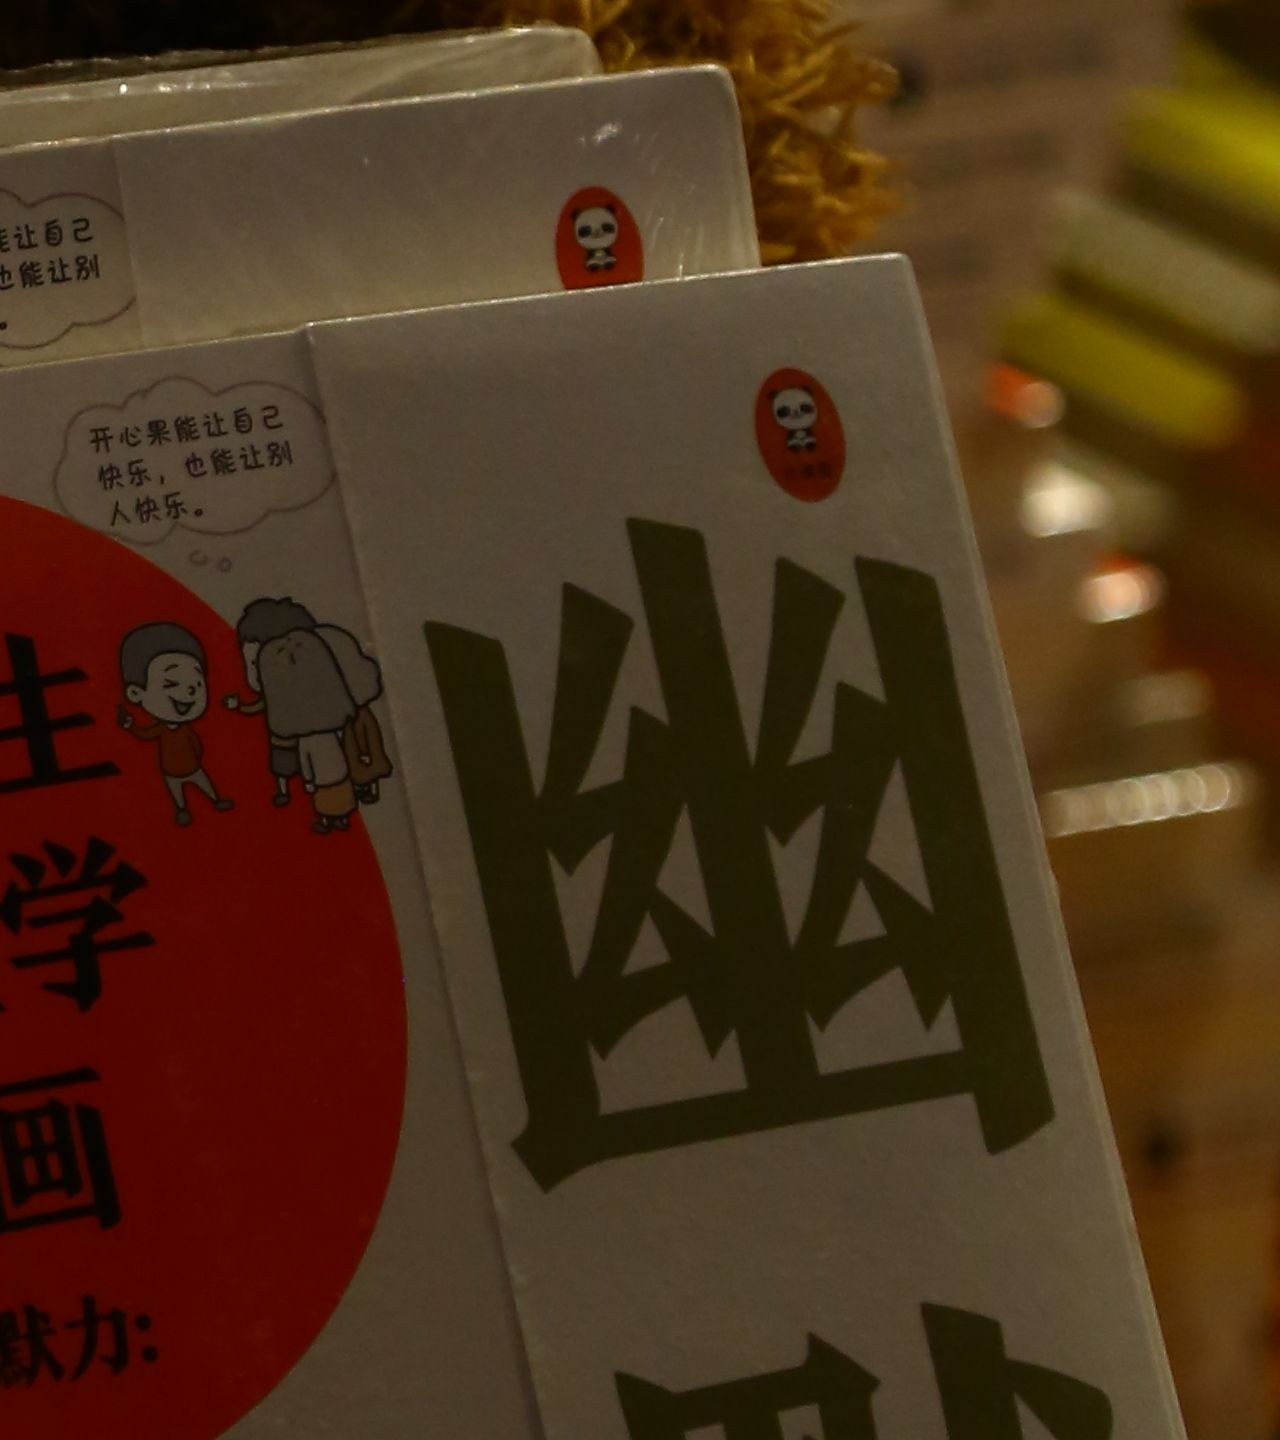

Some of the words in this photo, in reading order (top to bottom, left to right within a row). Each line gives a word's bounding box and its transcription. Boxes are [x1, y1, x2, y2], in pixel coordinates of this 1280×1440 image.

[89, 403, 286, 454] 开心果能让自己
[97, 440, 294, 491] 快乐，也能让别
[109, 493, 206, 528] 人快乐。
